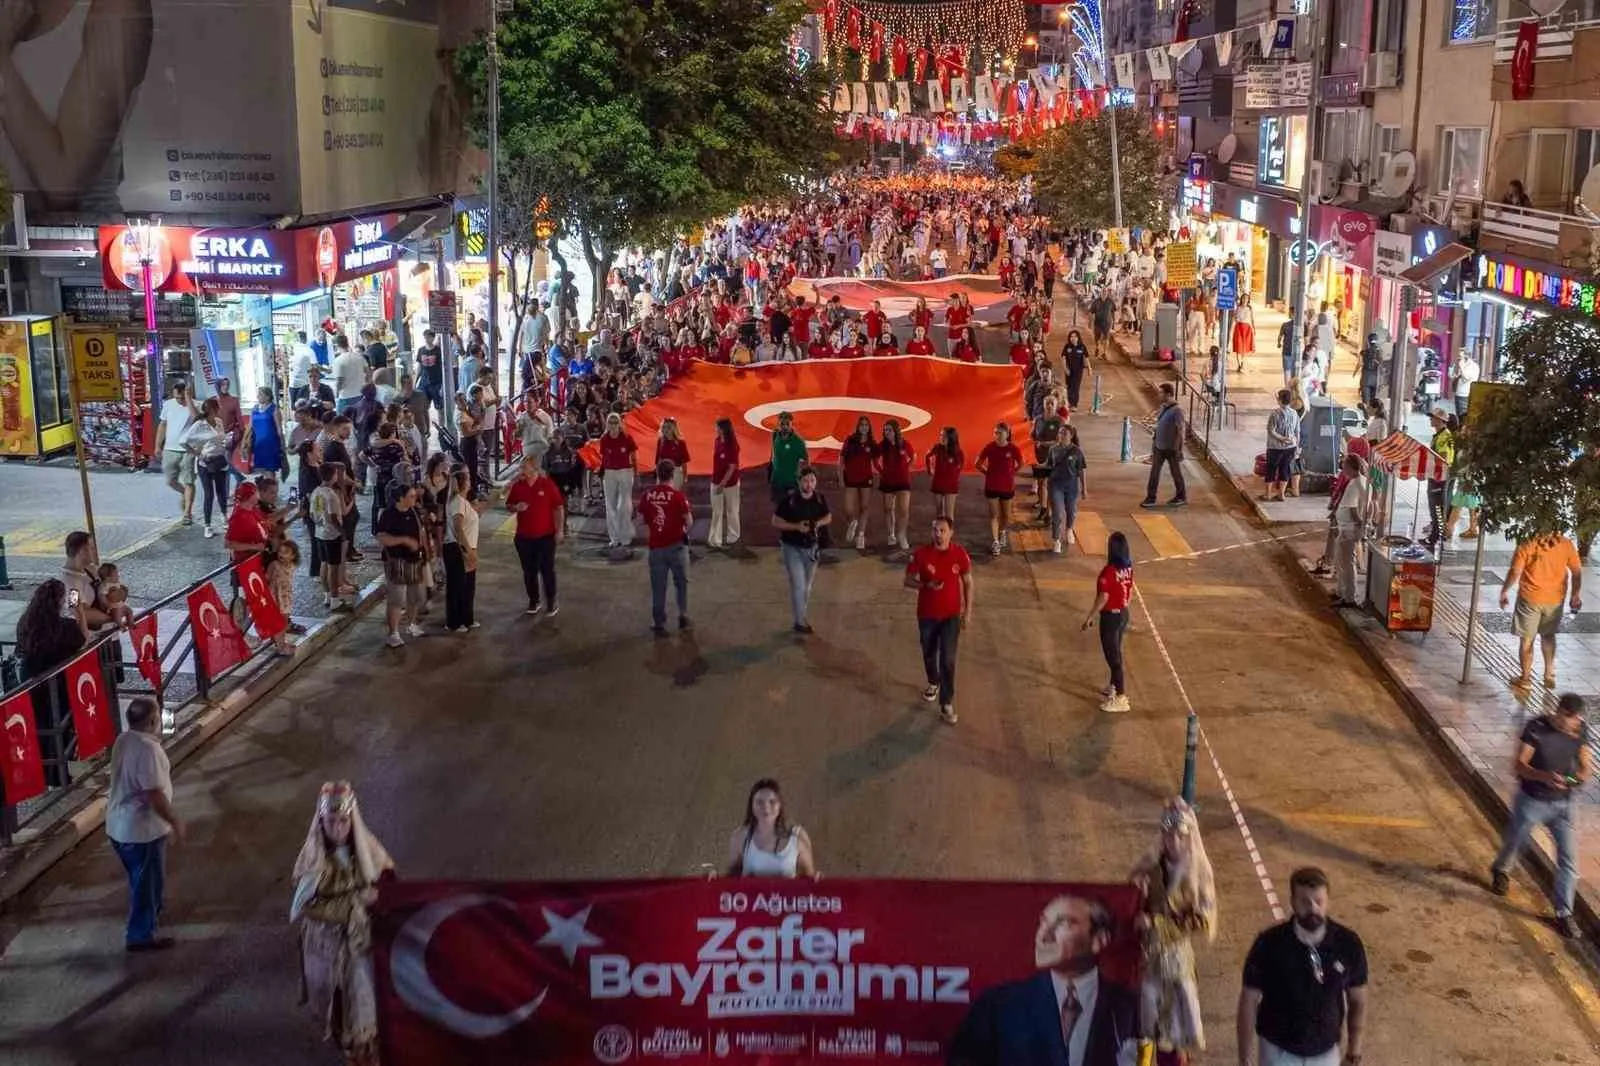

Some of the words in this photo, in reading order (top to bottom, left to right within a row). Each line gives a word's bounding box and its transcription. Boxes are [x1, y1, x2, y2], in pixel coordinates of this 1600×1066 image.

[353, 221, 383, 246] ERKA
[194, 236, 270, 258] ERKA
[217, 262, 283, 276] MARKET
[1219, 272, 1230, 294] P
[81, 368, 114, 380] TAKSİ
[719, 893, 748, 912] 30
[752, 892, 842, 915] Ağustos
[696, 914, 865, 963] Zafer
[589, 954, 970, 1006] Bayramımız
